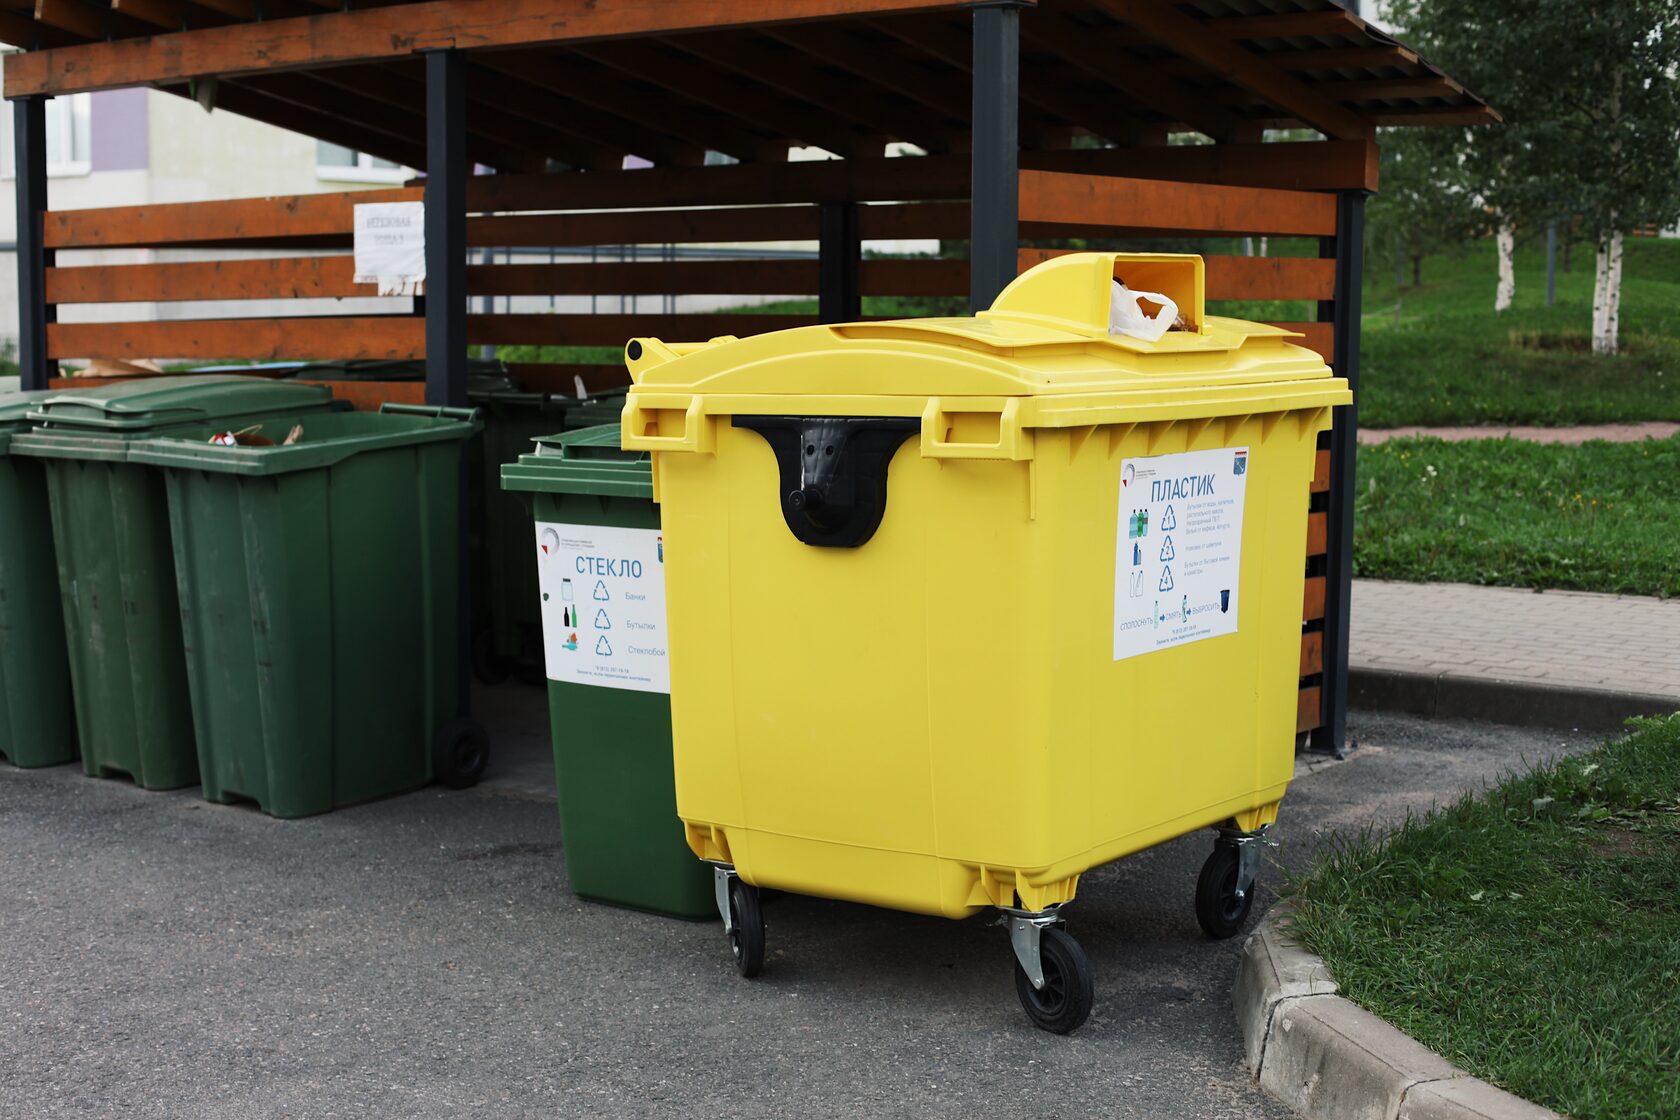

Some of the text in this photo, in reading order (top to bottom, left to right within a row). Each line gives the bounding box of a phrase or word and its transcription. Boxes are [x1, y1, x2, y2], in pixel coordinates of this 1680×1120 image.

[1151, 474, 1216, 502] ПЛАСТИК
[575, 556, 642, 578] СТЕКЛО
[625, 592, 646, 600] Банки
[1192, 602, 1220, 615] ВЫБРОСИТЬ
[1166, 610, 1182, 621] СМЯТЬ
[626, 620, 656, 630] Бутылки
[1120, 618, 1153, 631] СПОЛОСНУТЬ
[628, 646, 666, 656] Стеклобой
